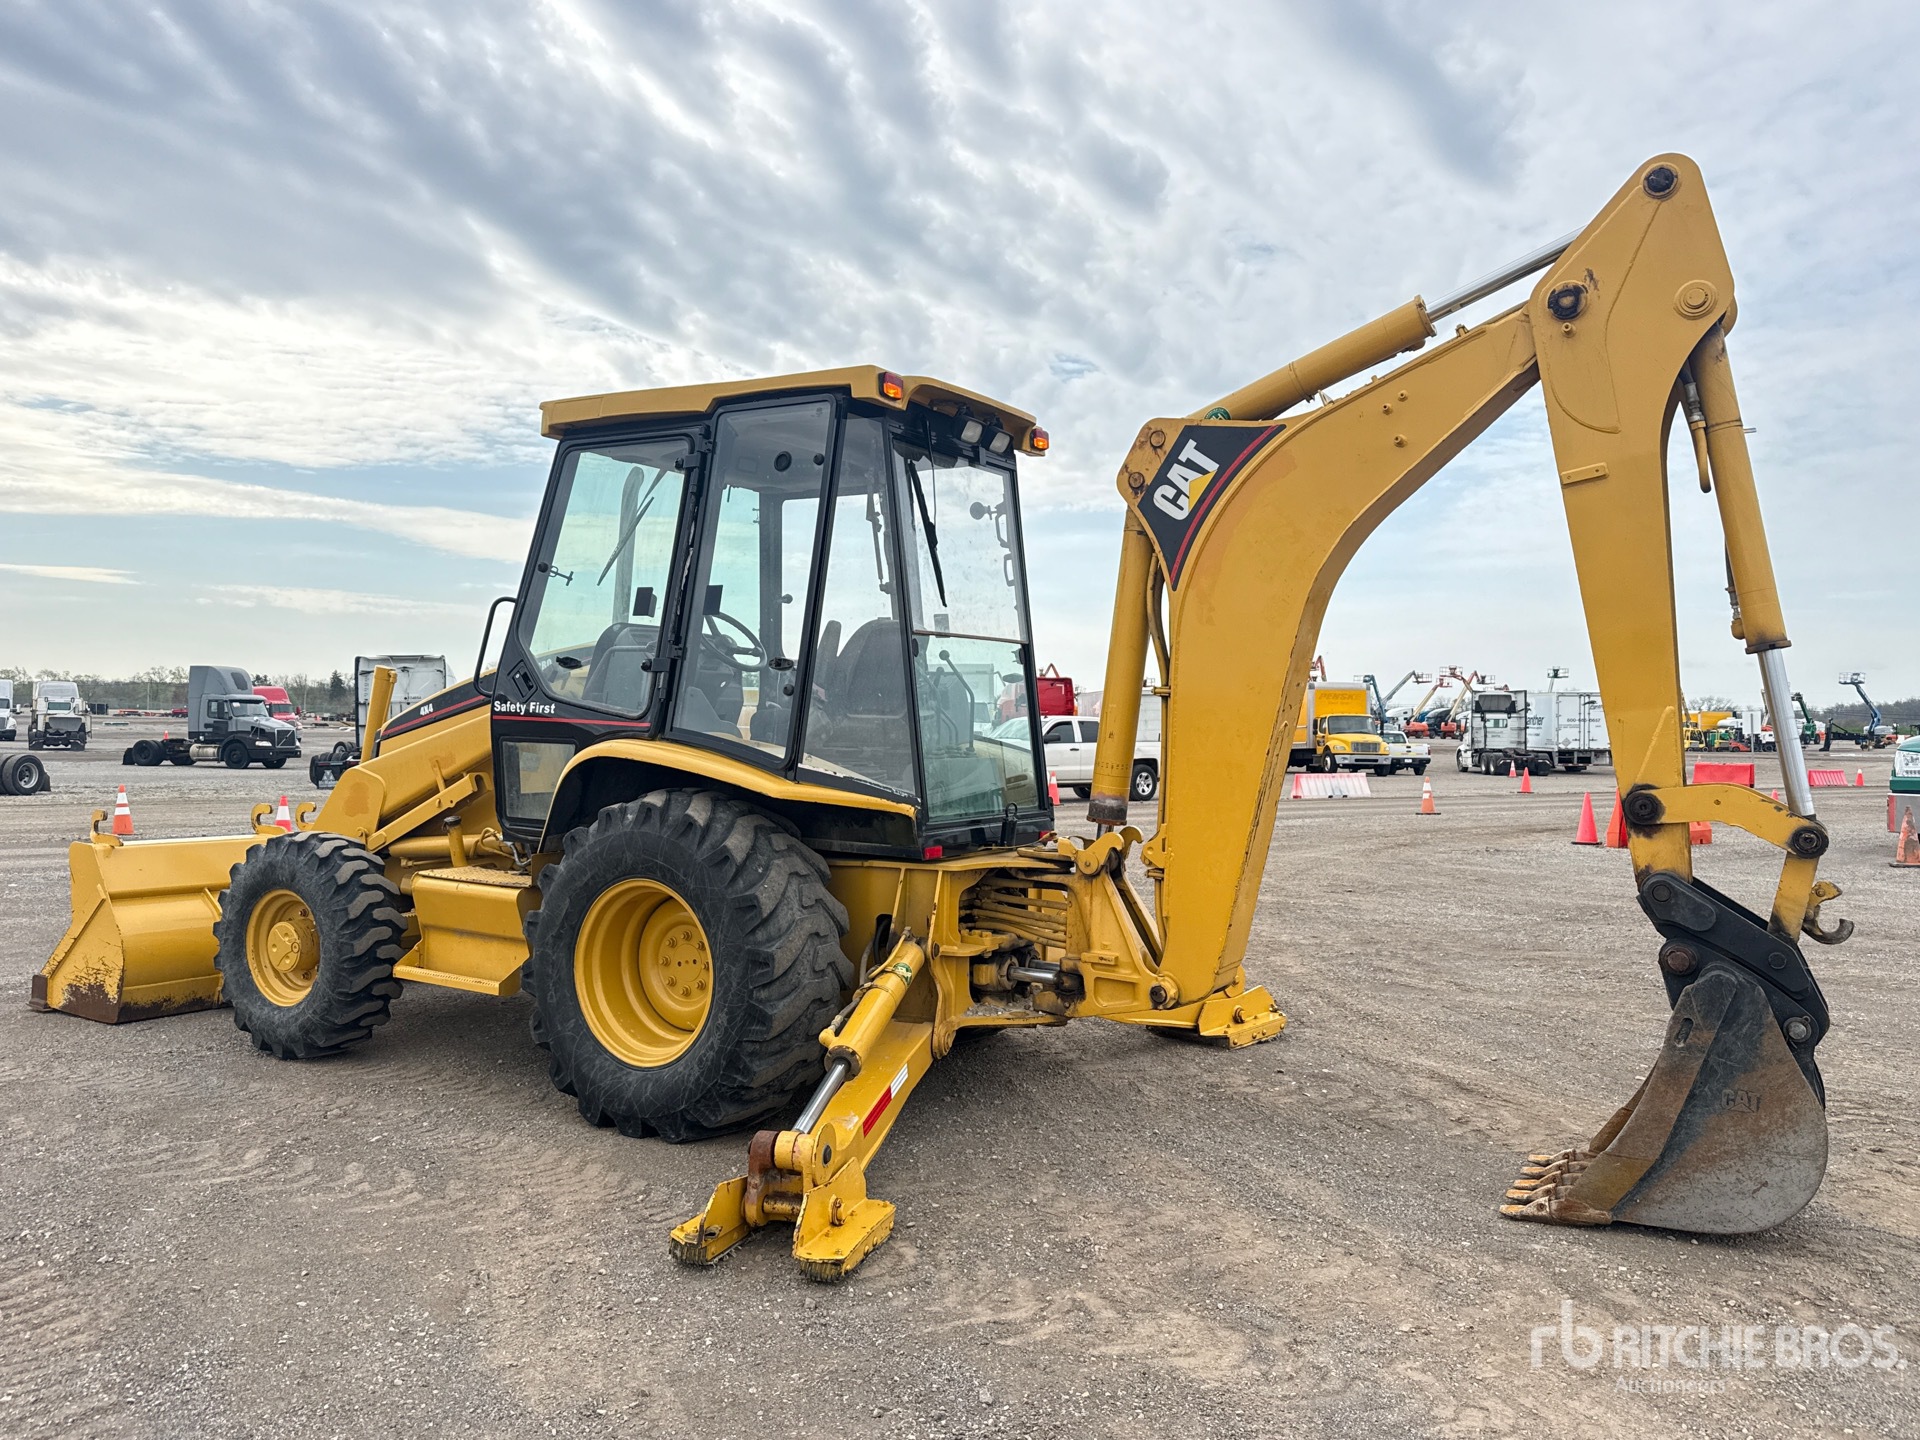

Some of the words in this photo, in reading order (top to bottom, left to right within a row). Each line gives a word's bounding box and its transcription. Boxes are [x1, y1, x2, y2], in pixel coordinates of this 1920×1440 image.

[1153, 439, 1220, 521] CAT
[494, 700, 527, 715] Safety
[529, 702, 556, 714] First
[1721, 1089, 1762, 1113] CAT
